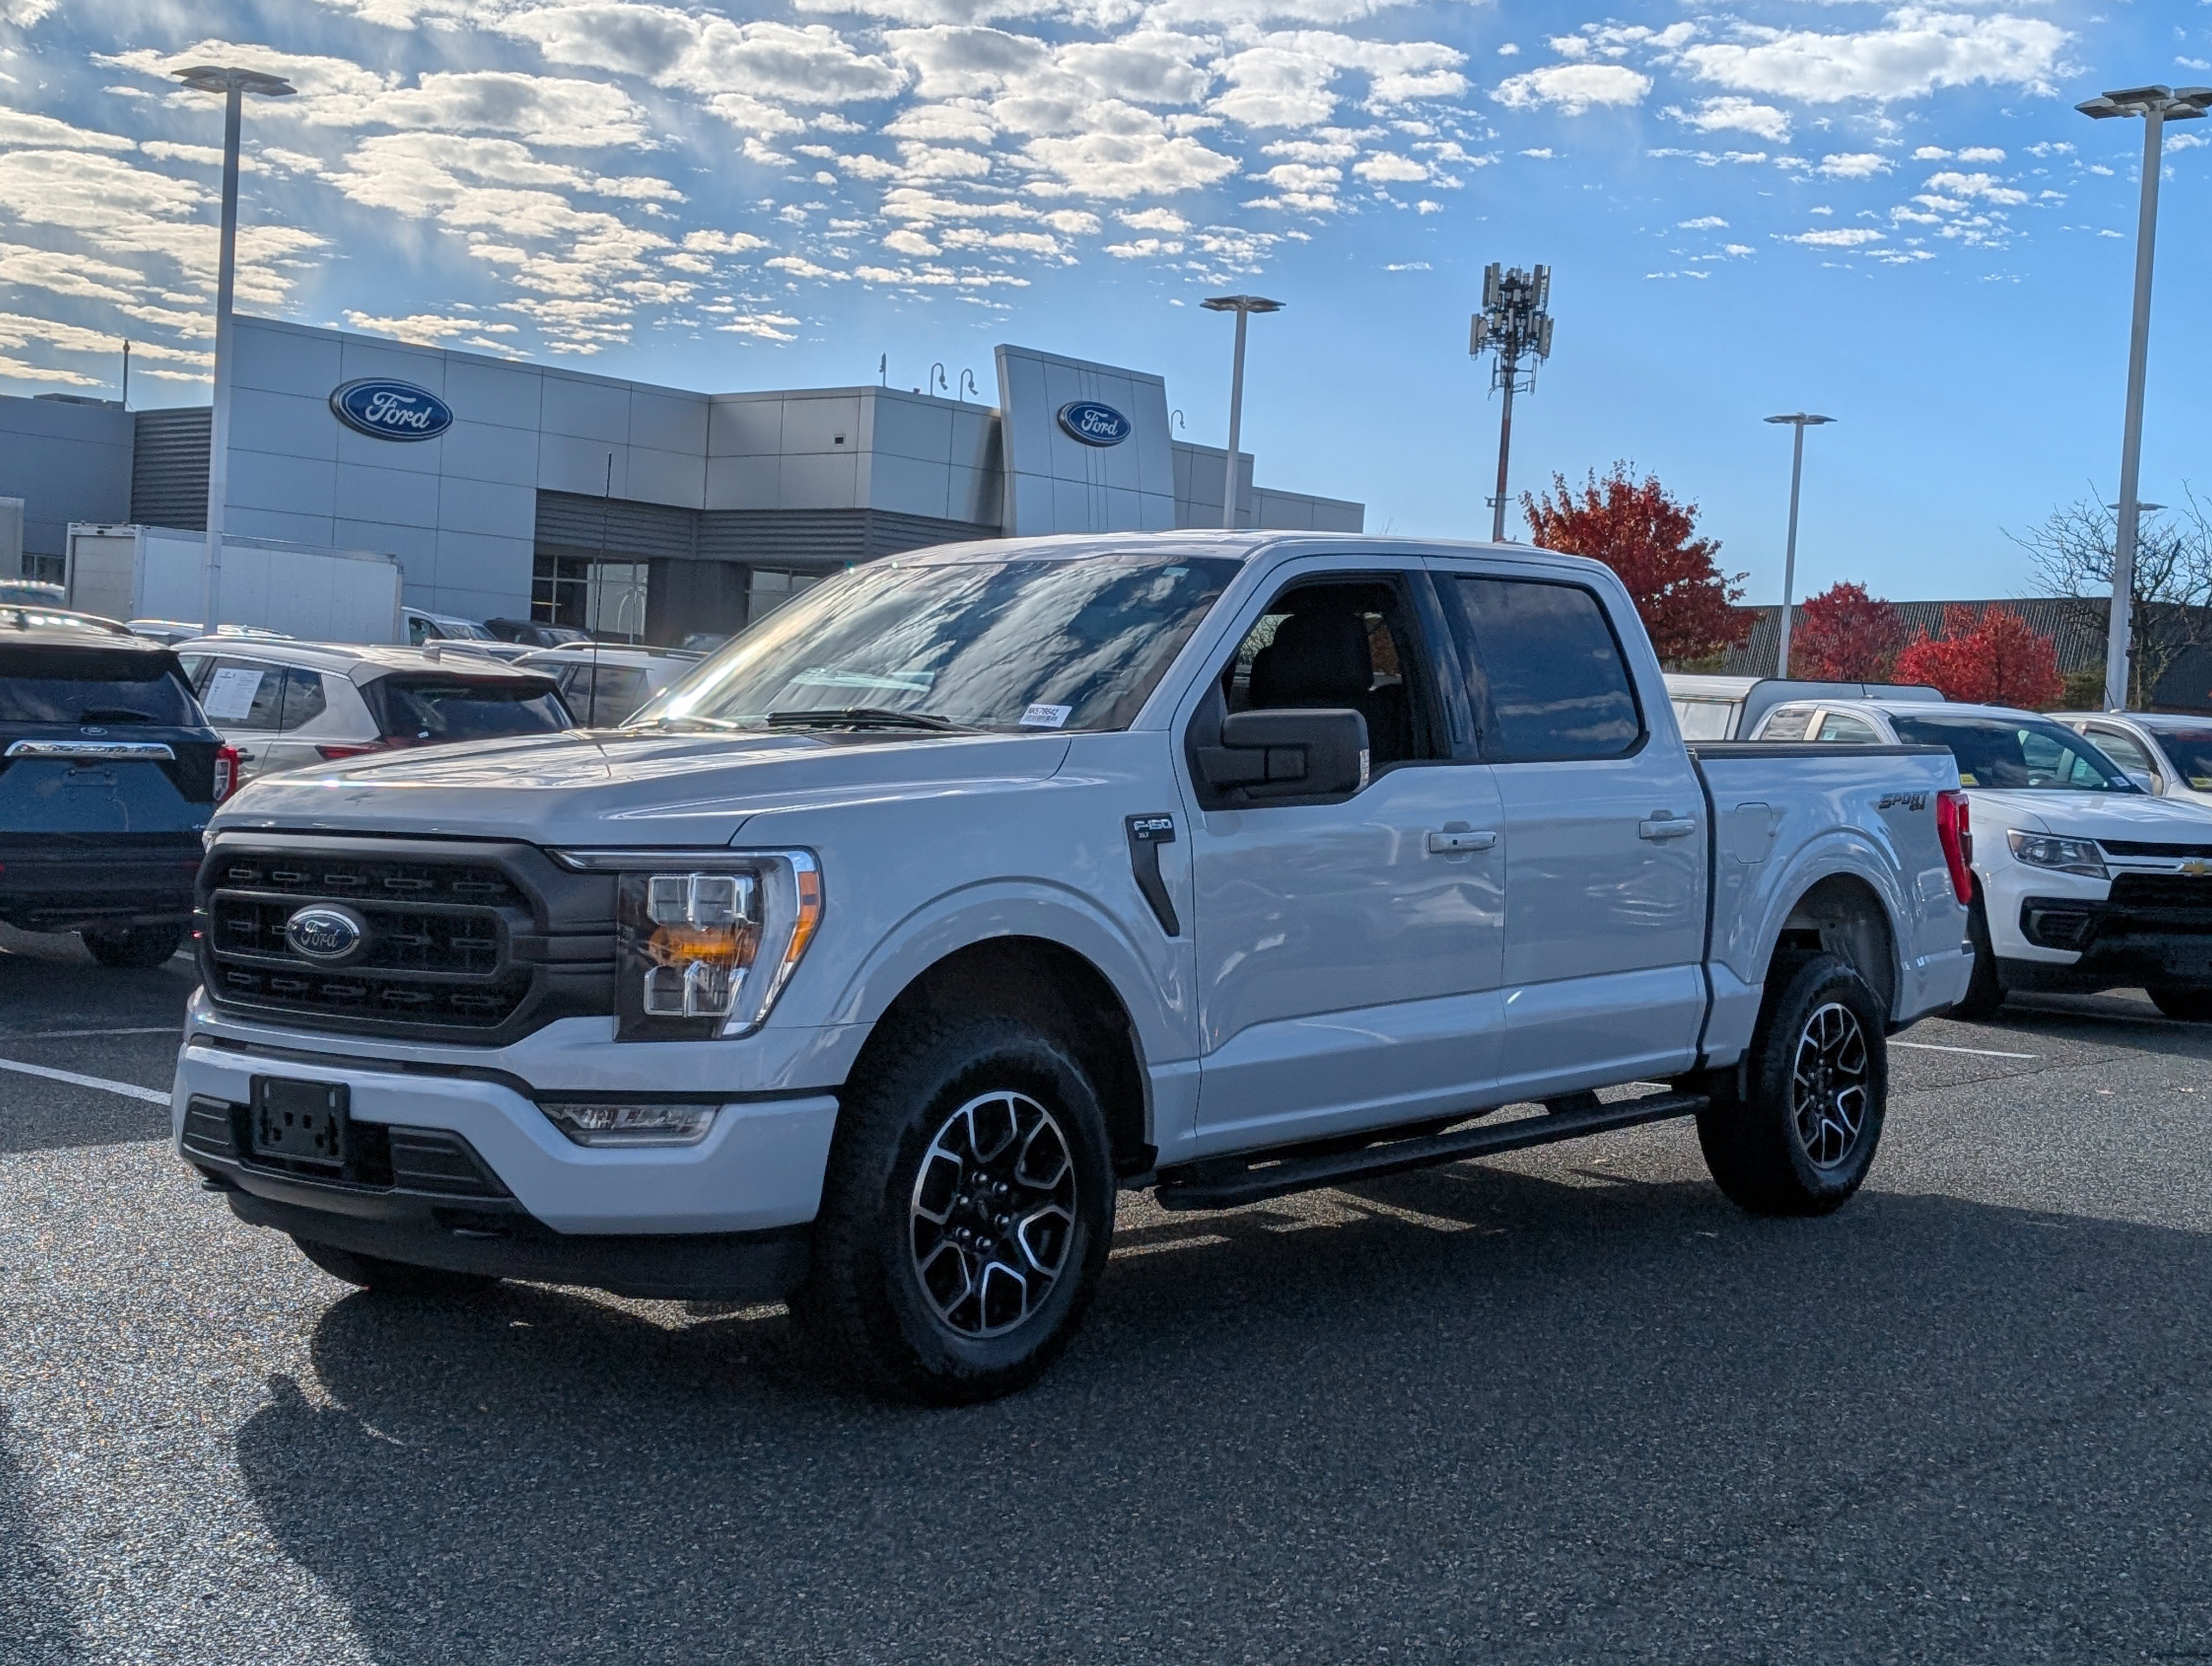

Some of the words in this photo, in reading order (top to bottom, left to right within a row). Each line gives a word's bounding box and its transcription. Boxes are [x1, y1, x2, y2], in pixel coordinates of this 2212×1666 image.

[365, 392, 432, 428] Ford
[1081, 409, 1118, 435] Ford
[1879, 791, 1930, 809] SPORT
[1134, 819, 1172, 831] F-150
[301, 920, 340, 947] Ford
